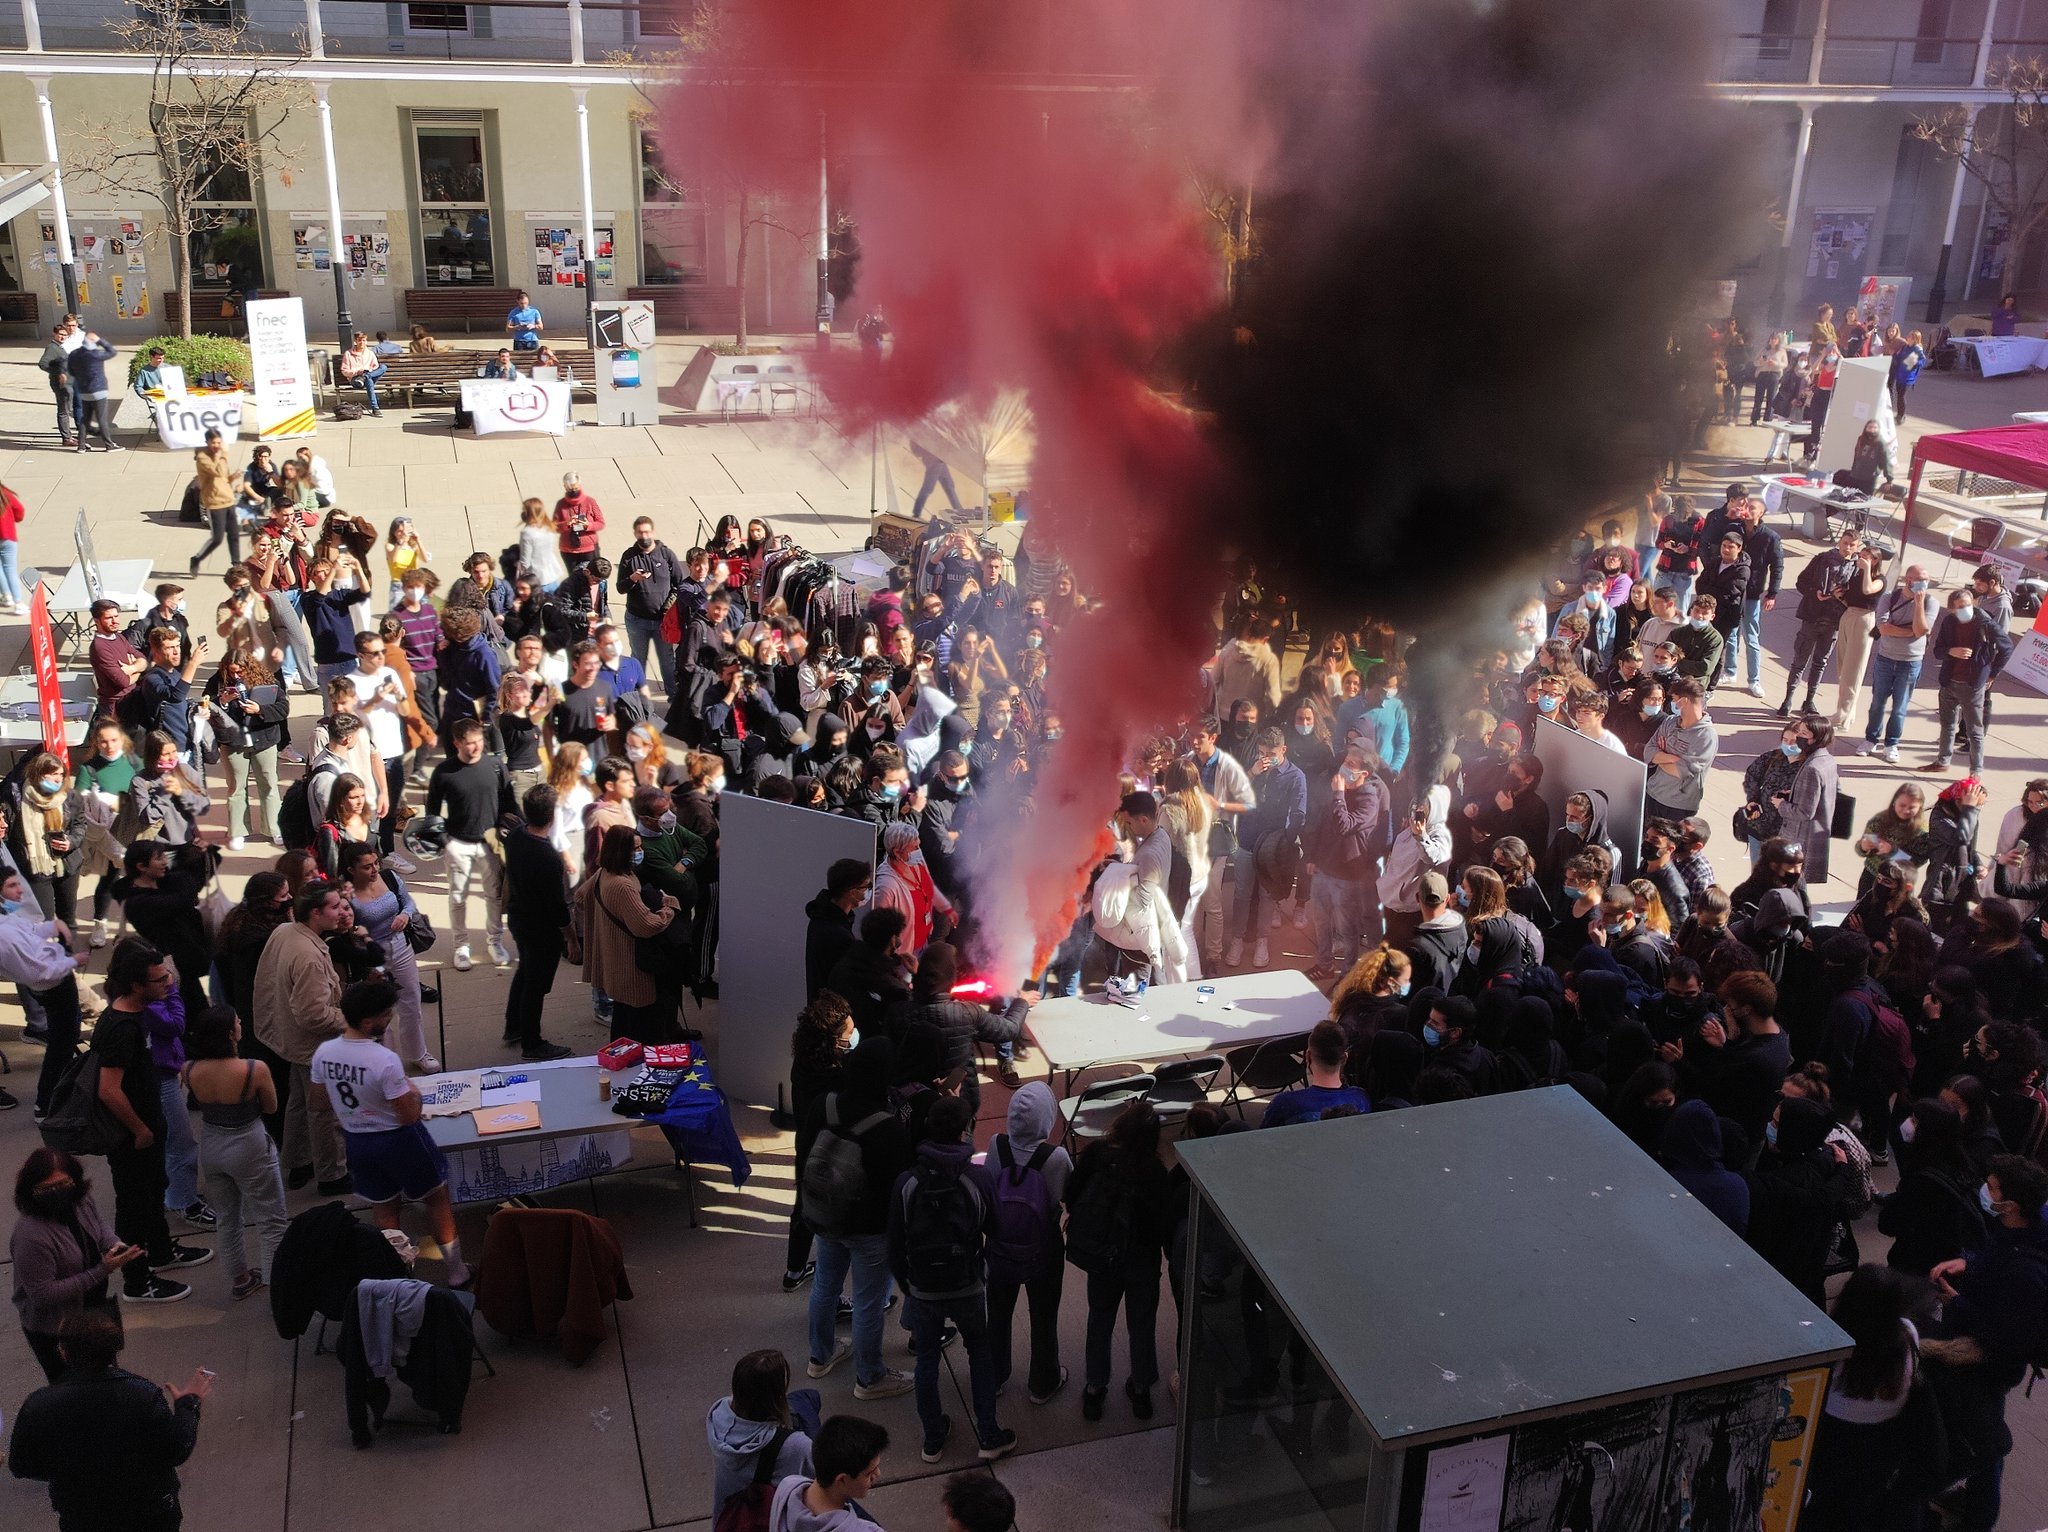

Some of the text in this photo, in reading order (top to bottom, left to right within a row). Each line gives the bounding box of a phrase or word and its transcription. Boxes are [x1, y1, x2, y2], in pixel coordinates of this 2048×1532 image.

[256, 312, 288, 327] fnec
[164, 399, 242, 432] fnec
[322, 1060, 366, 1086] TECCAT
[336, 1081, 360, 1110] 8
